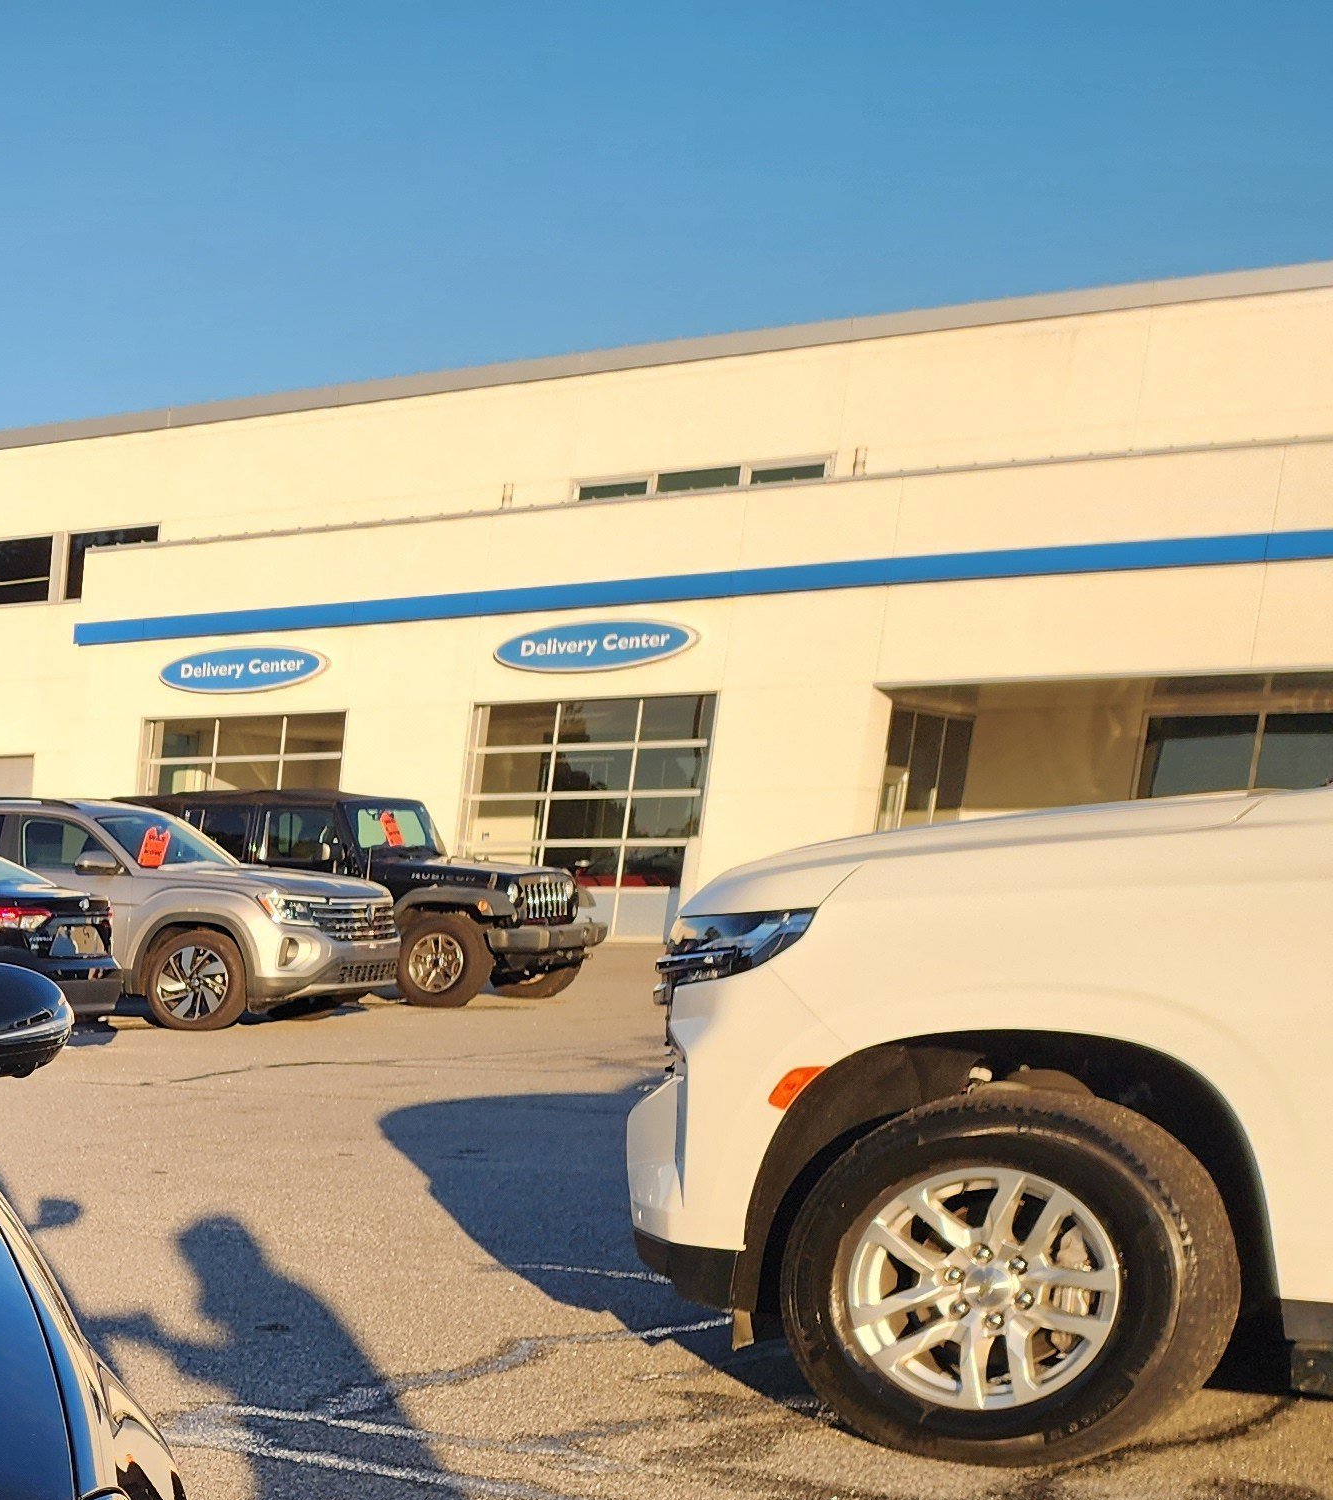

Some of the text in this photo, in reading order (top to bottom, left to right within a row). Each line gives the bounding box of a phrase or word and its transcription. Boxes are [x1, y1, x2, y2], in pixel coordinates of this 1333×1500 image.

[520, 632, 671, 657] Delivery Center
[180, 658, 305, 679] Delivery Center
